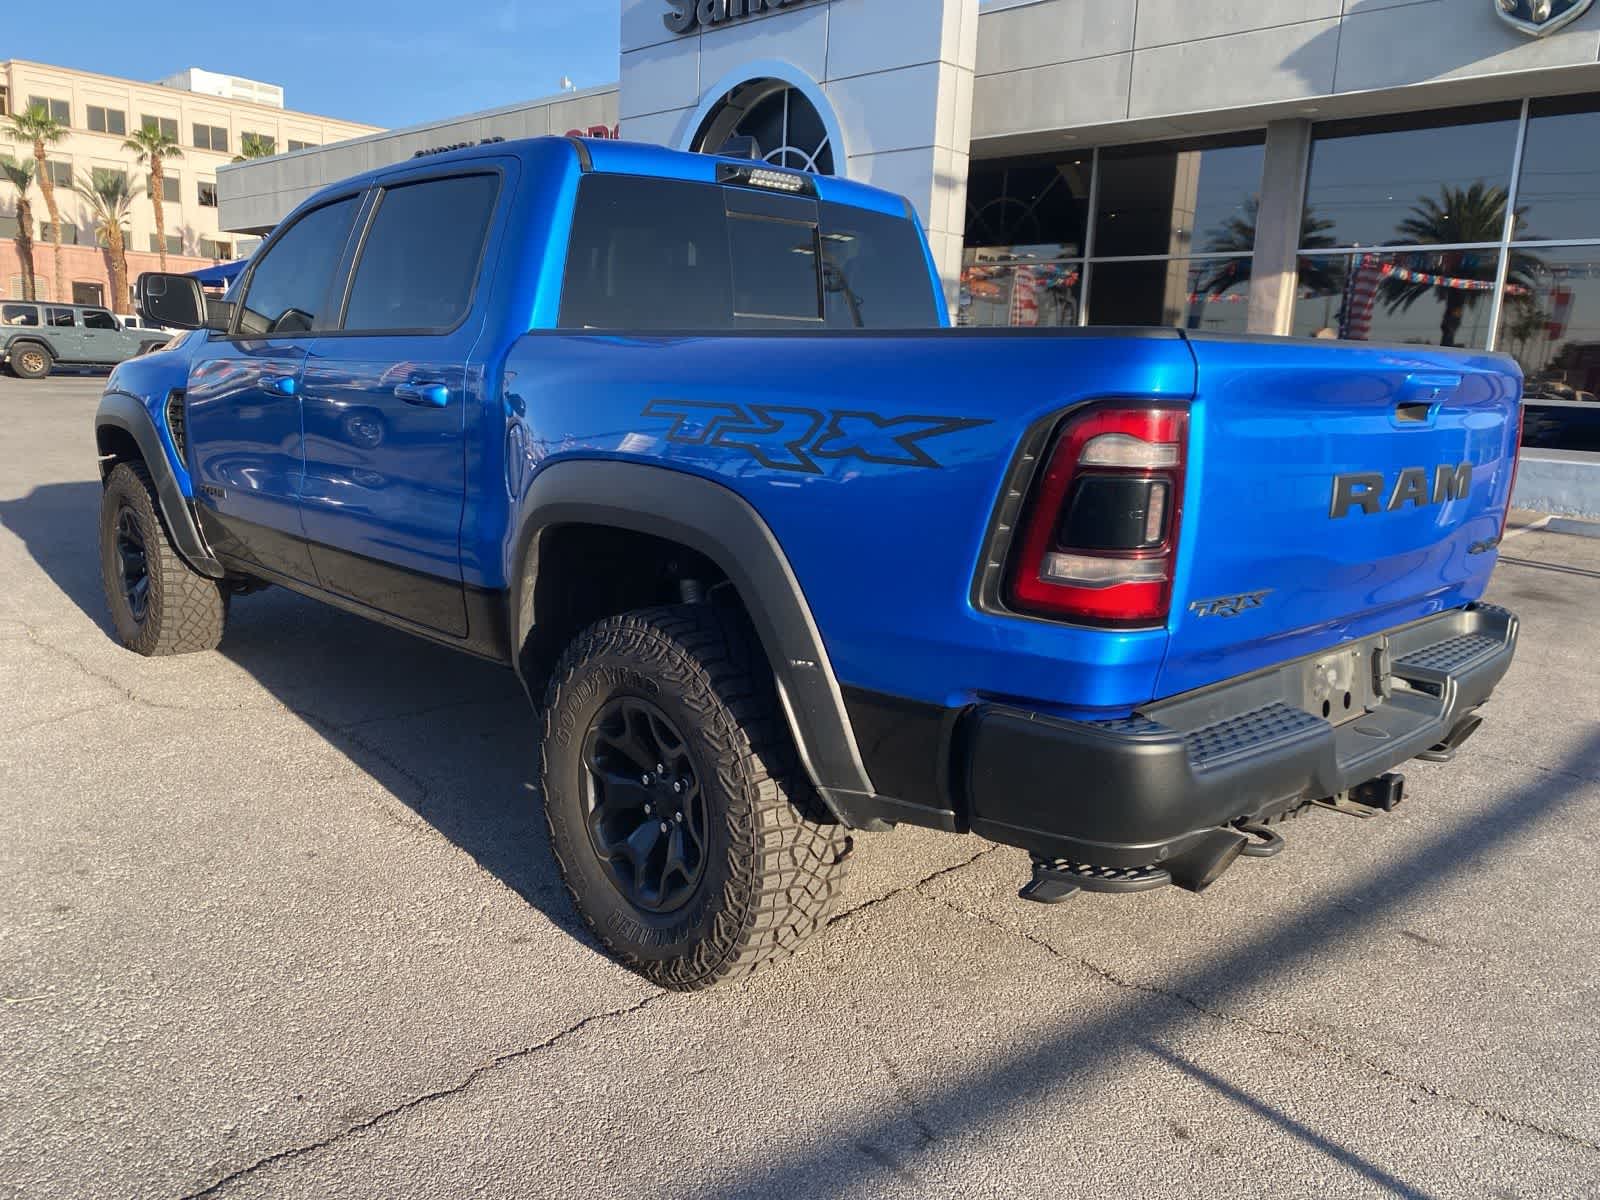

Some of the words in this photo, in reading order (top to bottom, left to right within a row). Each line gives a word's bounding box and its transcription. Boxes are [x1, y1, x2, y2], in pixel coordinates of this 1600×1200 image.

[640, 399, 994, 475] TRX
[1328, 461, 1473, 520] RAM
[1187, 588, 1275, 618] TRX
